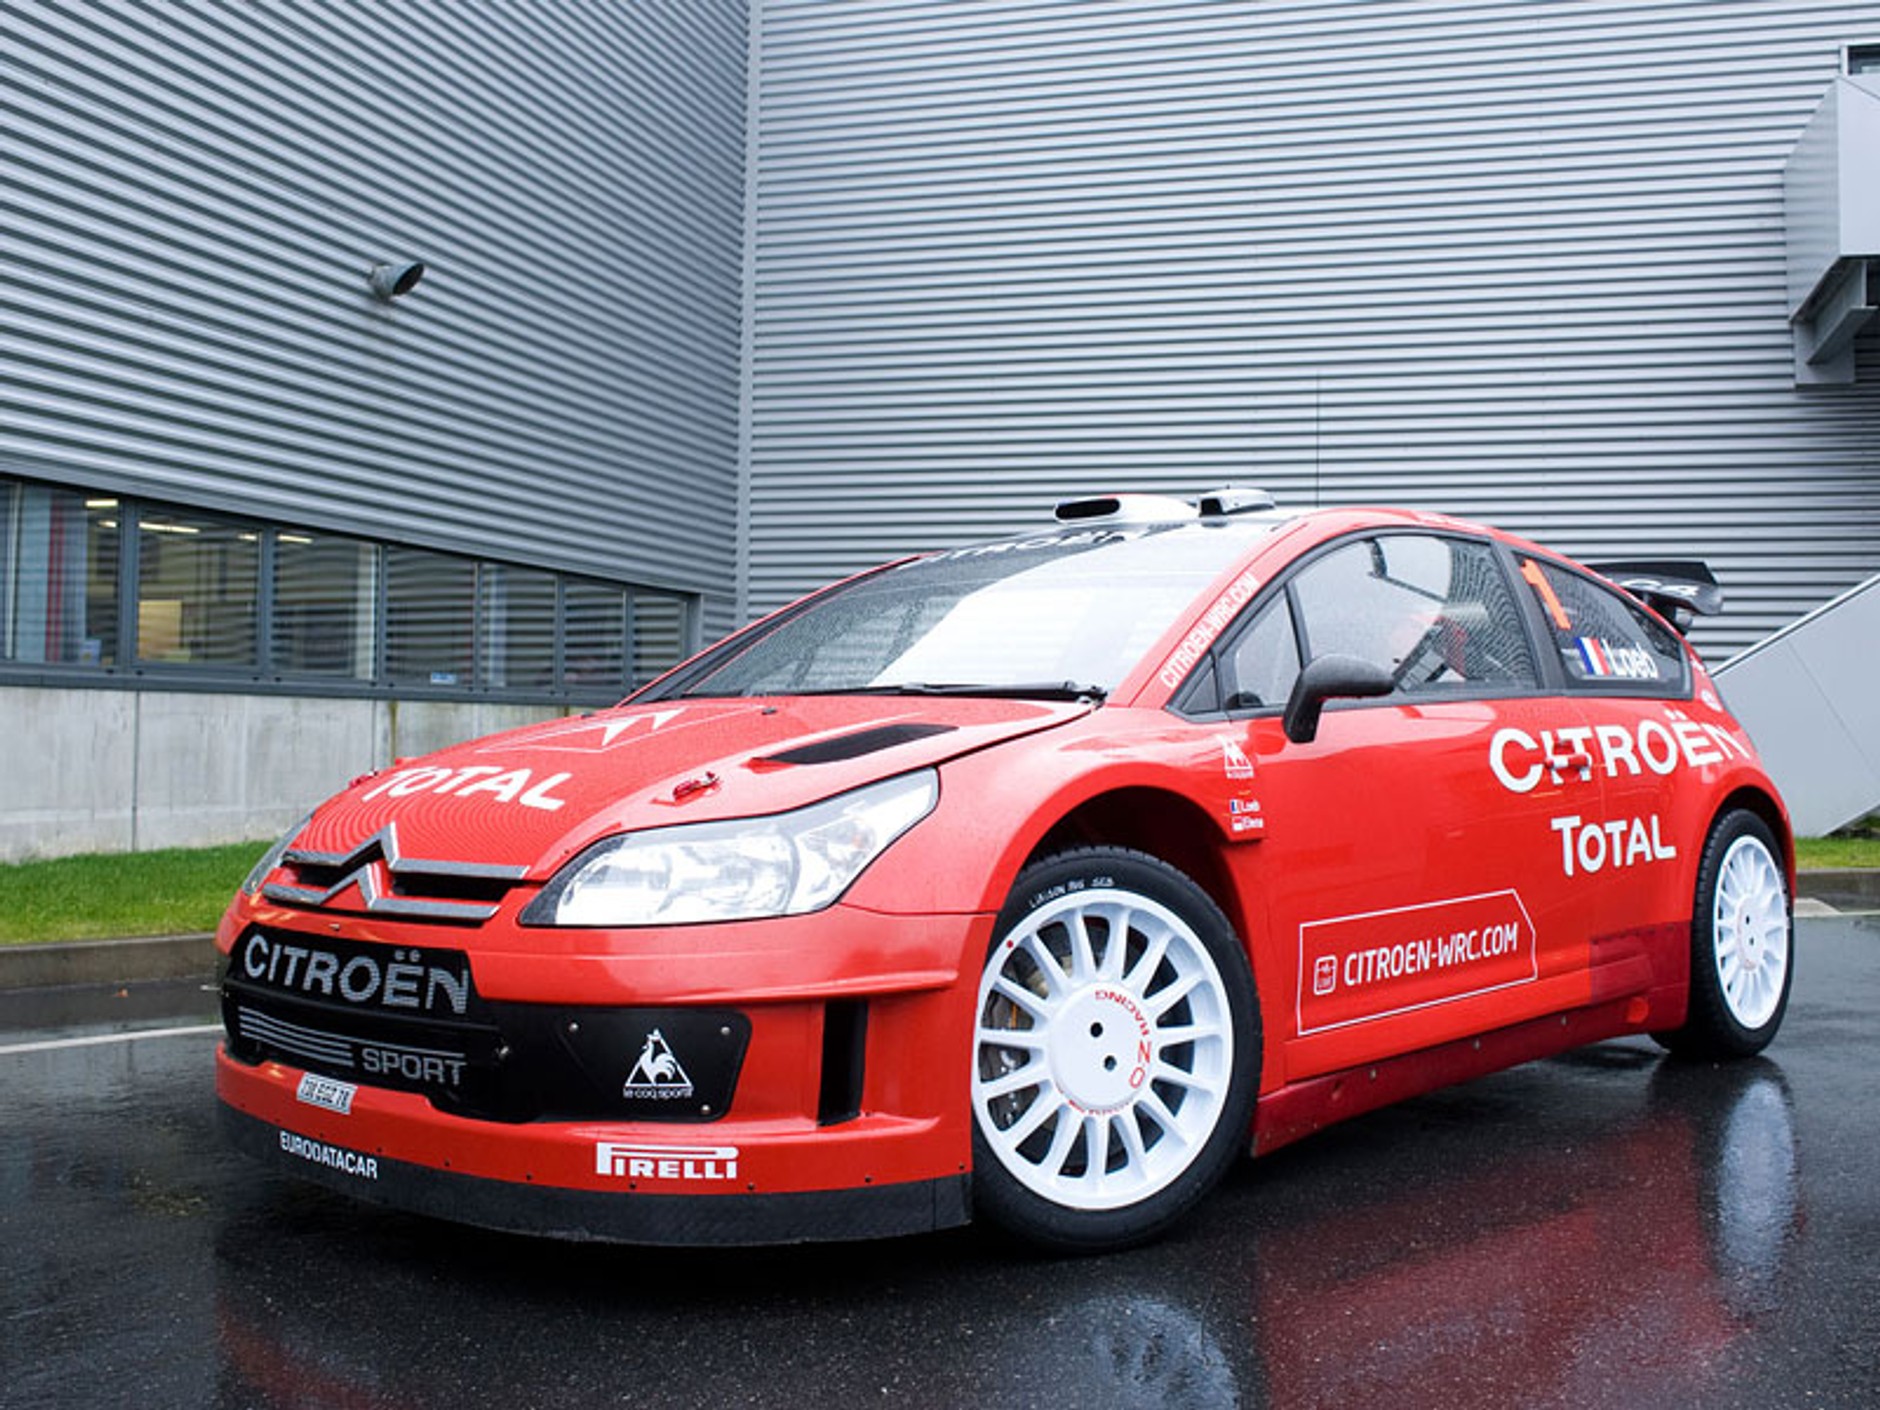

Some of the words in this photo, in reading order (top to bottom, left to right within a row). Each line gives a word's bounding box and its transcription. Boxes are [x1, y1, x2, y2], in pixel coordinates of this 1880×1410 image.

[1520, 559, 1571, 630] 1
[1160, 570, 1261, 688] CITROEN-WRC.COM
[1600, 637, 1659, 680] Loeb
[1489, 709, 1751, 793] CITROËN
[361, 766, 572, 811] TOTAL
[1551, 814, 1677, 877] TOTAL
[244, 933, 470, 1014] CITROËN
[1343, 922, 1519, 986] CITROEN-WRC.COM
[361, 1046, 467, 1086] SPORT
[280, 1129, 378, 1180] EURODATACAR
[596, 1142, 737, 1179] PIRELLI
